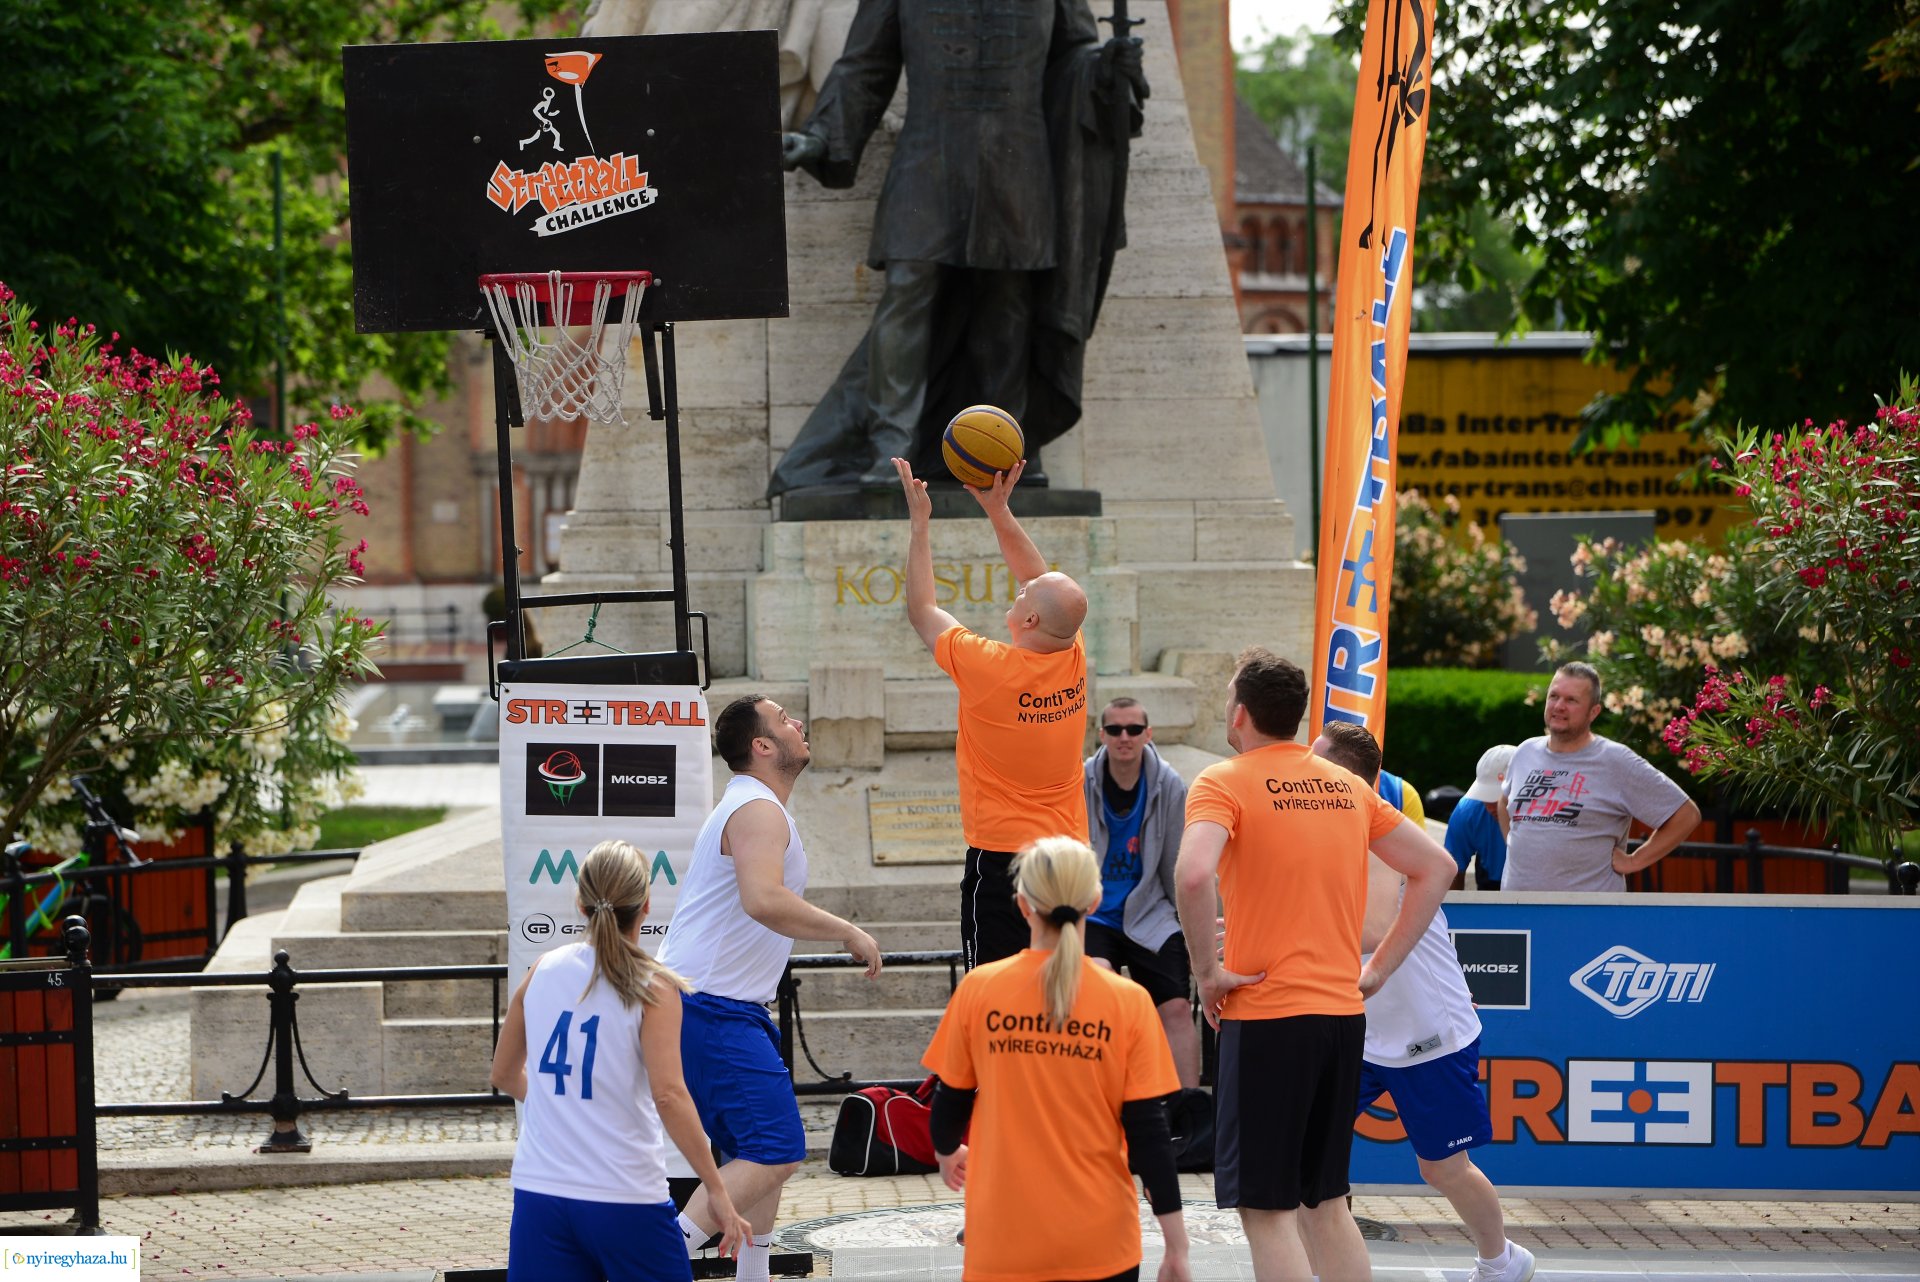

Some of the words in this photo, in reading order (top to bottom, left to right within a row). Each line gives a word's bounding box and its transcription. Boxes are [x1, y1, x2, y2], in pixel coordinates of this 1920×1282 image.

[545, 190, 650, 232] CHALLENGE
[506, 698, 706, 727] STREETBALL
[611, 774, 668, 785] MKOSZ
[1265, 778, 1353, 795] ContiTech
[1524, 775, 1556, 786] WE
[1516, 785, 1560, 799] GOT
[1273, 796, 1357, 811] NYÍREGYHÁZA
[1462, 963, 1519, 974] MKOSZ
[1602, 962, 1717, 1003] TOTI
[538, 1010, 600, 1100] 41
[989, 1035, 1103, 1062] NYÍREGYHÁZA
[1456, 1135, 1473, 1146] JAKO
